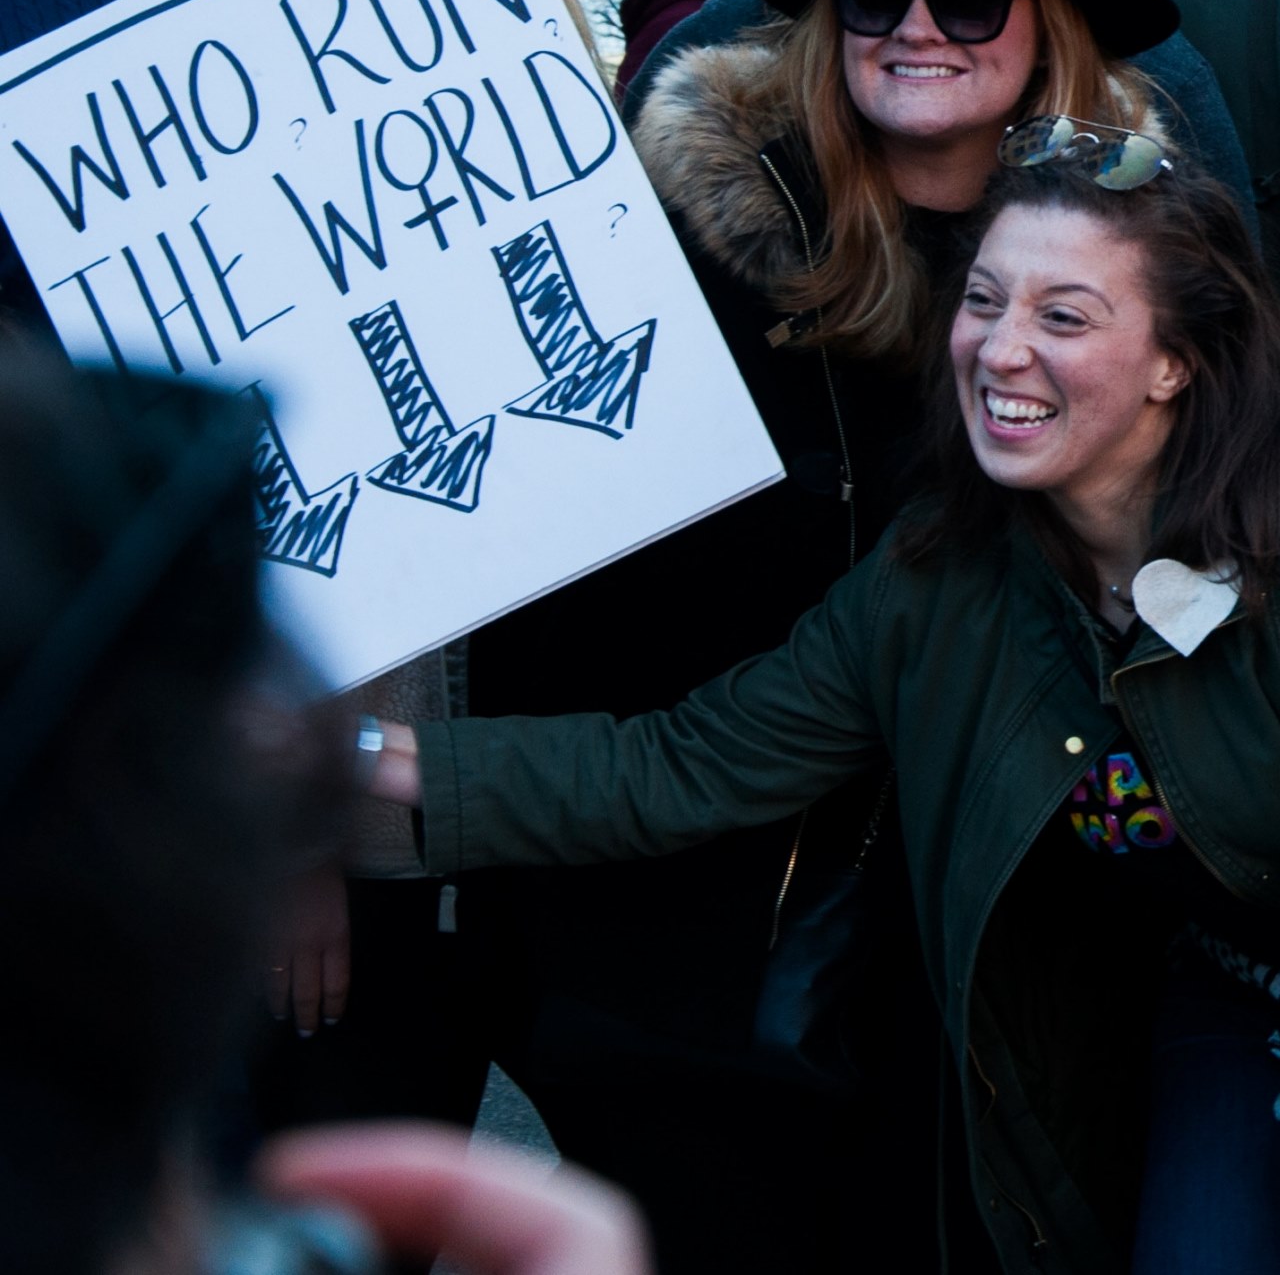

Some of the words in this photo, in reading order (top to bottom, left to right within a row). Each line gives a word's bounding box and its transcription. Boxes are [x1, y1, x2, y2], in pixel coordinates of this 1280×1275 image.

[12, 39, 260, 233] WHO
[48, 205, 296, 377] THE
[272, 50, 617, 296] WORLD
